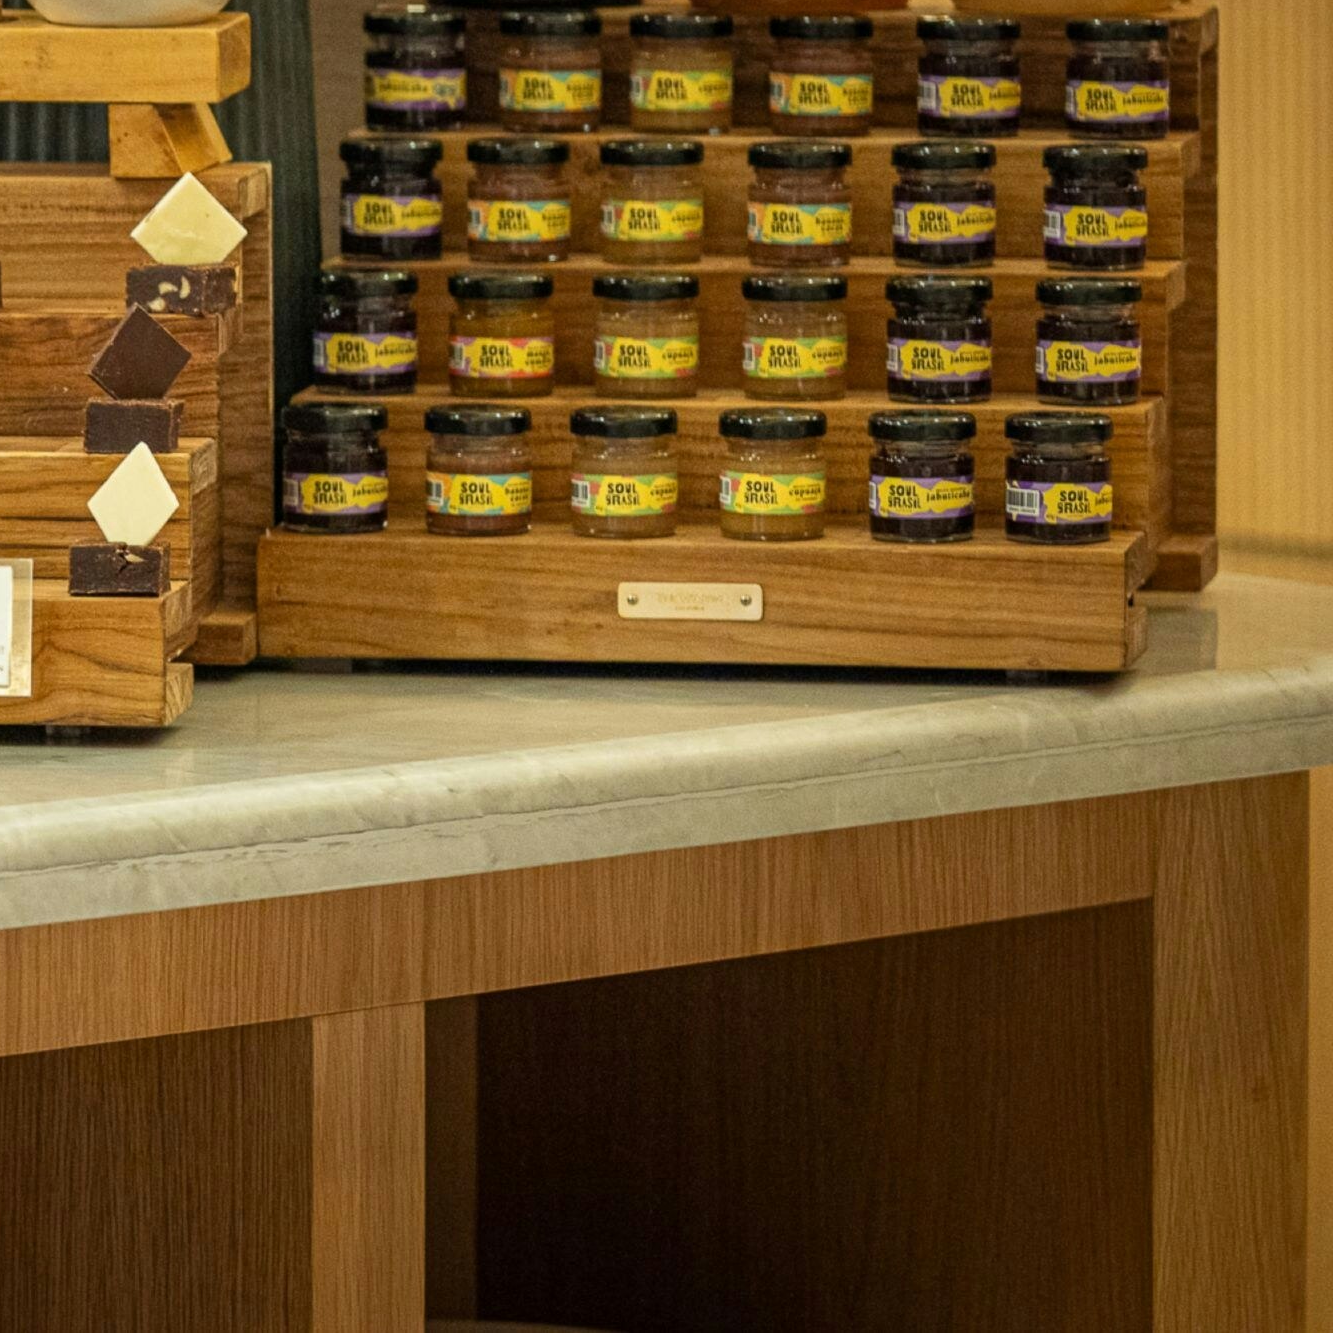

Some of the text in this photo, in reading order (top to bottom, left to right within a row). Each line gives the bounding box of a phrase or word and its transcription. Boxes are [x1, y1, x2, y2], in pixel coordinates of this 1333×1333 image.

[523, 77, 552, 88] SOUL
[657, 77, 684, 88] SOUL
[799, 81, 828, 92] SOUL
[953, 83, 981, 95] SOUL
[1087, 88, 1114, 99] SOUL
[366, 202, 394, 213] SOUL
[499, 208, 526, 219] SOUL
[630, 208, 658, 219] SOUL
[773, 211, 799, 222] SOUL
[920, 210, 948, 221] SOUL
[1077, 213, 1106, 224] SOUL
[338, 341, 366, 352] SOUL
[481, 344, 510, 355] SOUL
[620, 344, 647, 355] SOUL
[770, 345, 797, 356] SOUL
[913, 347, 941, 358] SOUL
[1057, 348, 1085, 359] SOUL
[315, 481, 344, 492] SOUL
[461, 482, 490, 493] SOUL
[607, 483, 637, 494] SOUL
[746, 481, 775, 492] SOUL
[889, 484, 918, 496] SOUL
[313, 493, 347, 505] BRASIL
[459, 494, 492, 505] BRASIL
[606, 494, 640, 506] BRASIL
[744, 492, 778, 504] BRASIL
[1060, 490, 1088, 502] SOUL
[888, 496, 921, 508] BRASIL
[1058, 502, 1091, 514] BRASIL
